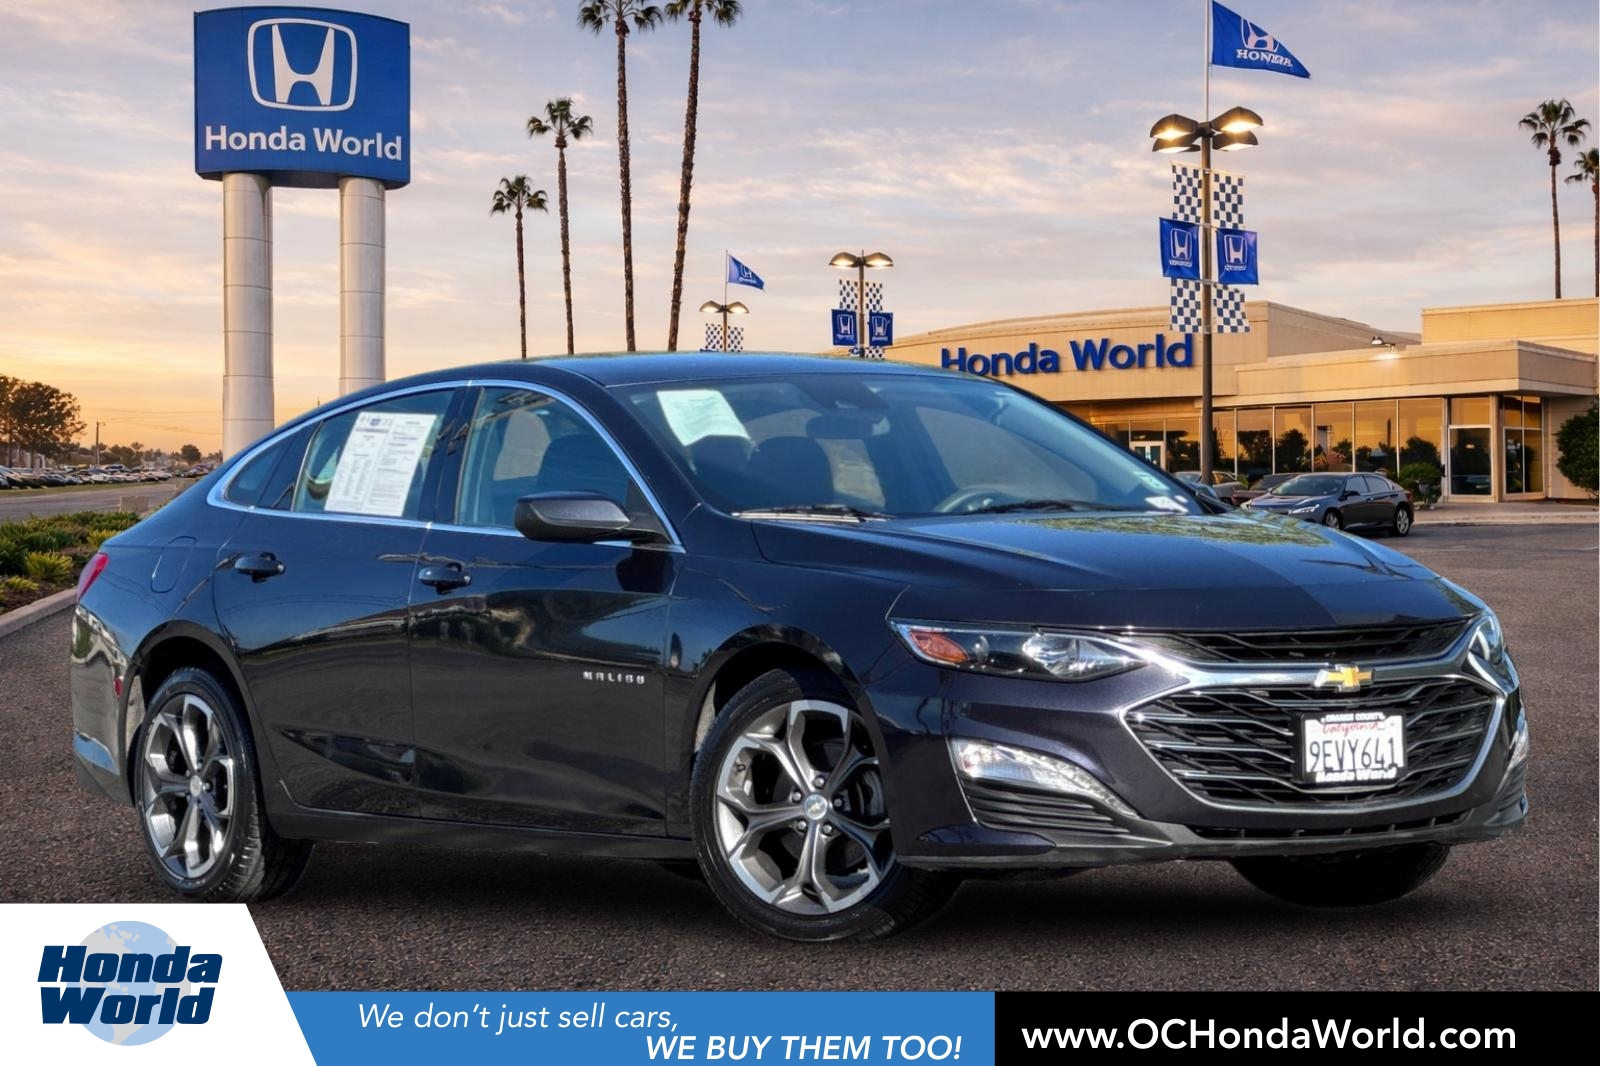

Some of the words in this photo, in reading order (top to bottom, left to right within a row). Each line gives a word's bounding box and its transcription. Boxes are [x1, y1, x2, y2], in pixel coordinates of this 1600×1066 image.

[205, 125, 306, 151] Honda
[313, 127, 402, 161] World
[941, 342, 1063, 377] Honda
[1069, 333, 1194, 371] World
[583, 671, 645, 685] MALIBU
[1309, 736, 1399, 773] 9EVY641
